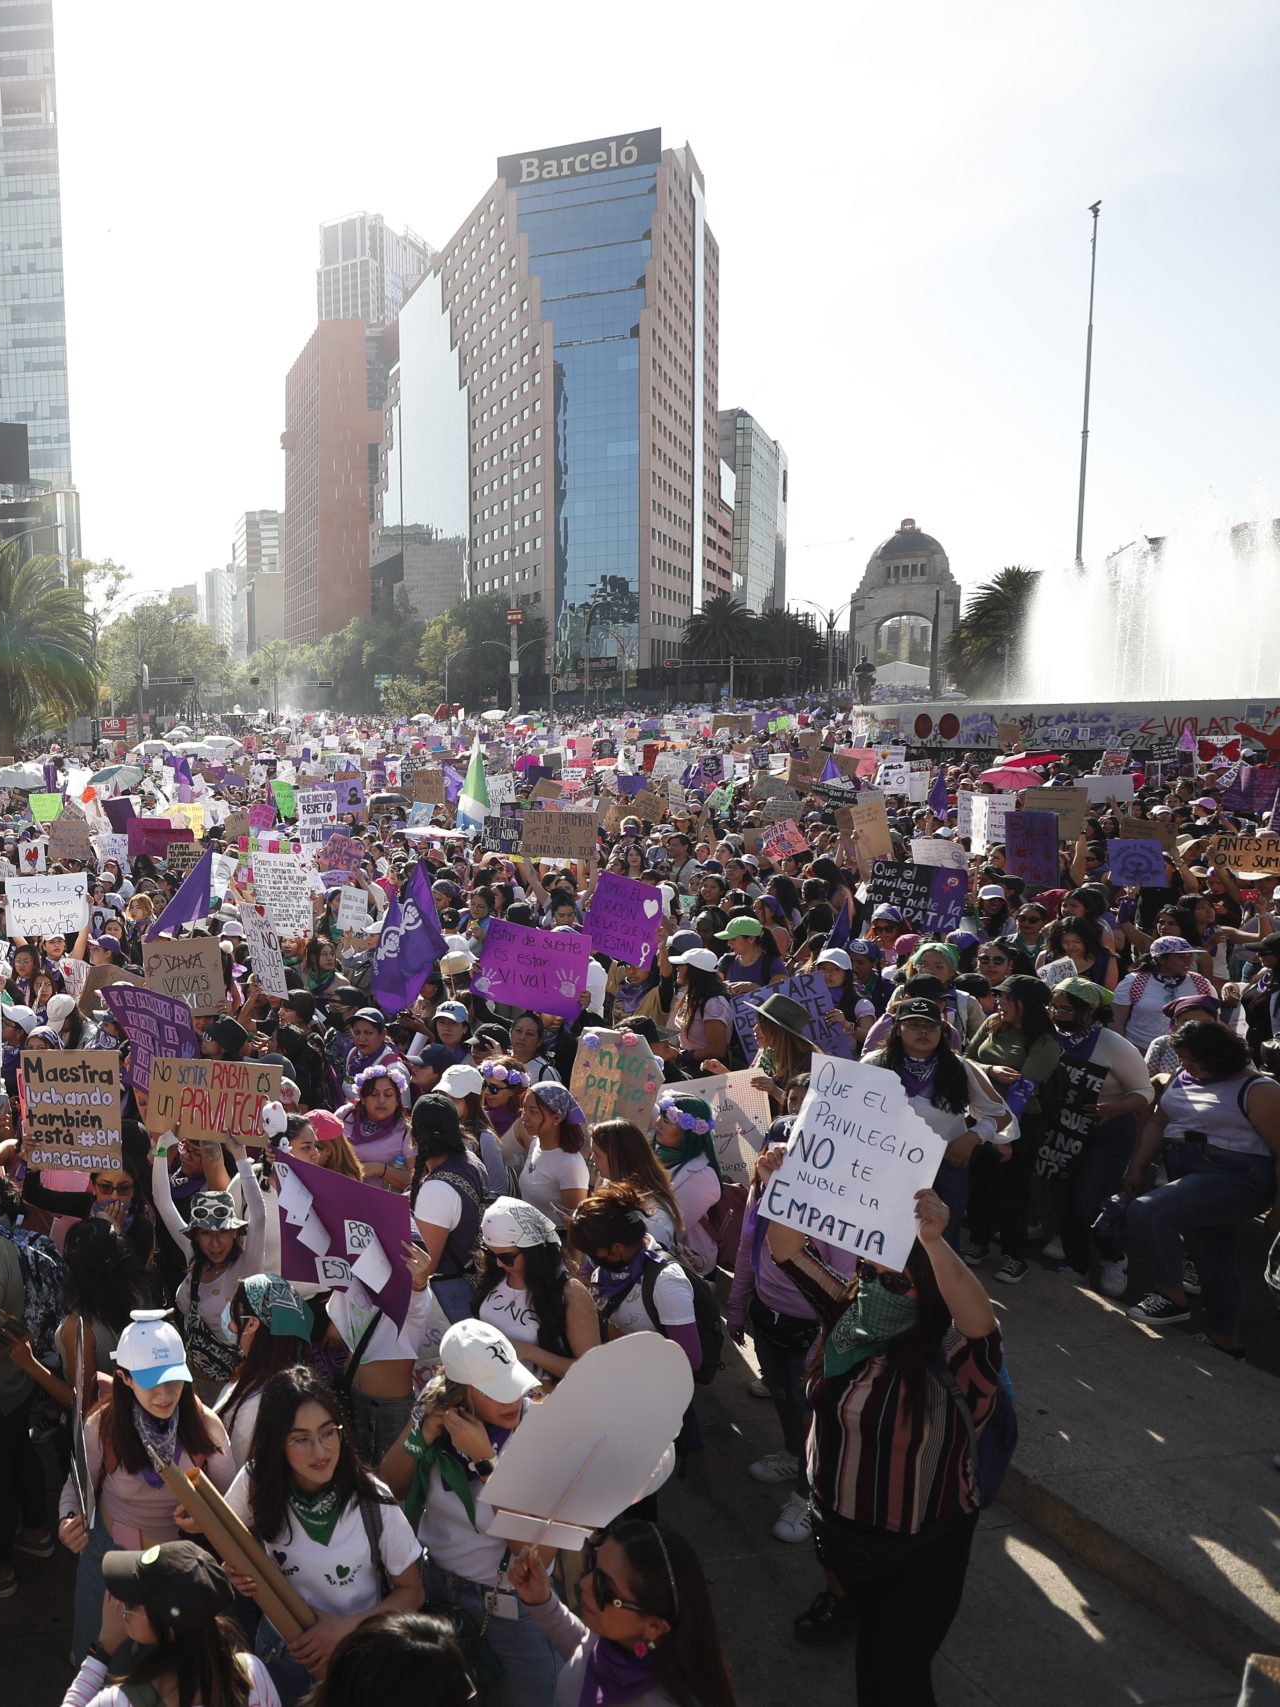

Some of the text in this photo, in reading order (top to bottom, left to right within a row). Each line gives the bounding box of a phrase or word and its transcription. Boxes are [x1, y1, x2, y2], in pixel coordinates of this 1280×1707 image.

[520, 137, 637, 183] Barceló
[104, 720, 119, 728] MB
[302, 803, 332, 814] RESPETO
[528, 813, 593, 827] SOY LA ENFERMERA
[544, 826, 569, 834] DE LAS
[533, 844, 566, 855] NUNCA VAS
[1217, 838, 1262, 852] ANTES
[1214, 854, 1244, 867] QUE
[874, 862, 918, 880] Que el
[11, 881, 71, 895] Todas las
[629, 888, 642, 901] EL
[13, 897, 40, 909] Madres
[867, 891, 961, 916] no te nuble la
[59, 910, 79, 921] hijos
[23, 920, 76, 935] VOLVER
[590, 914, 601, 928] DE
[602, 918, 620, 932] LAS
[640, 929, 652, 941] YA
[261, 931, 278, 951] NO
[491, 925, 582, 955] Estar de suerte
[591, 931, 601, 944] NO
[494, 949, 550, 967] es estar
[271, 968, 279, 977] LA
[735, 1012, 756, 1031] DE
[23, 1056, 114, 1085] Maestra
[153, 1060, 171, 1082] No
[210, 1062, 250, 1090] RABIA
[257, 1072, 271, 1093] es
[816, 1062, 889, 1113] QUE EL
[157, 1093, 174, 1118] un
[26, 1107, 103, 1129] también
[1060, 1108, 1093, 1135] QUE
[77, 1129, 120, 1147] #8M
[815, 1101, 925, 1164] PRIVILEGIO
[788, 1130, 836, 1170] NO
[1055, 1132, 1083, 1155] NO
[31, 1149, 121, 1169] enseñando
[796, 1170, 880, 1211] NUBLE LA
[767, 1179, 886, 1256] EMPATIA
[348, 1221, 374, 1238] POR
